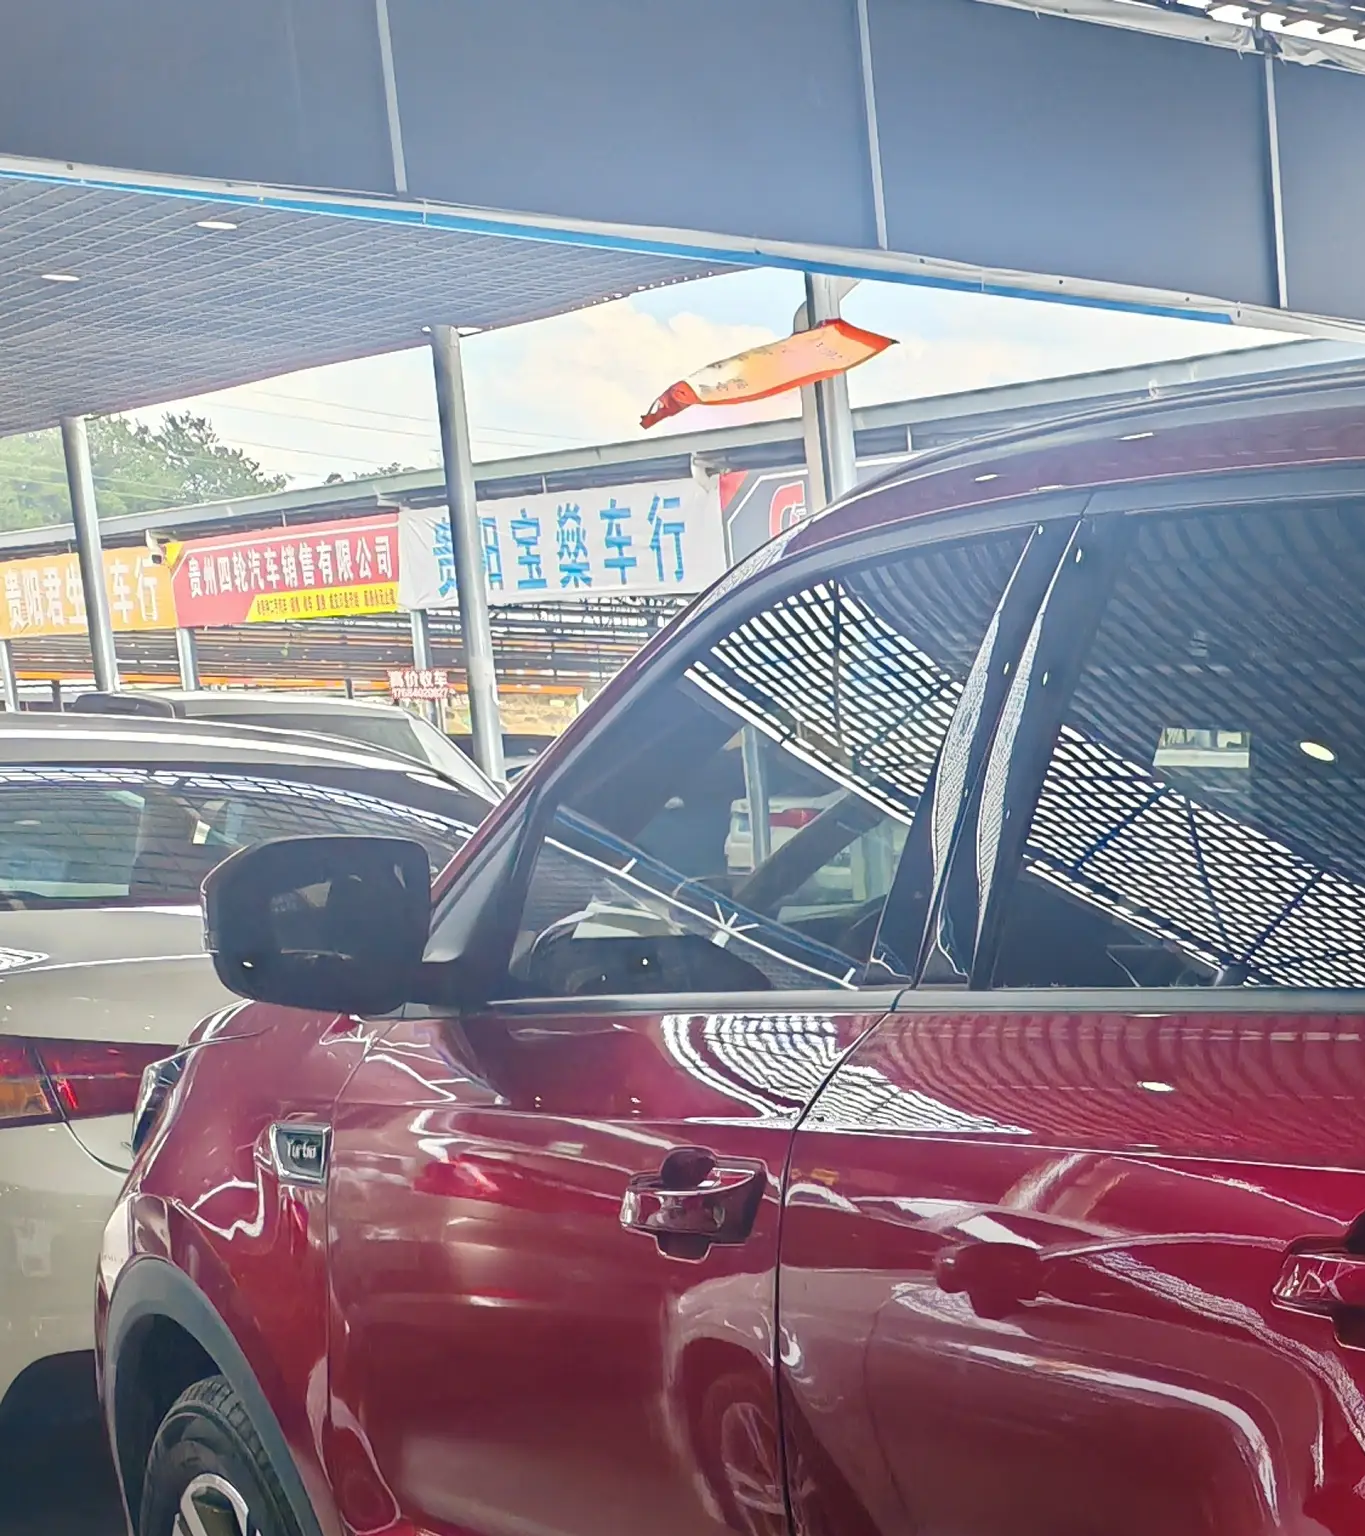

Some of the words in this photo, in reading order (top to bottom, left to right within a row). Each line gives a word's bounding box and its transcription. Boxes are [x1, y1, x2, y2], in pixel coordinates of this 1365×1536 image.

[187, 535, 394, 599] 贵州四轮汽车销售有限公司
